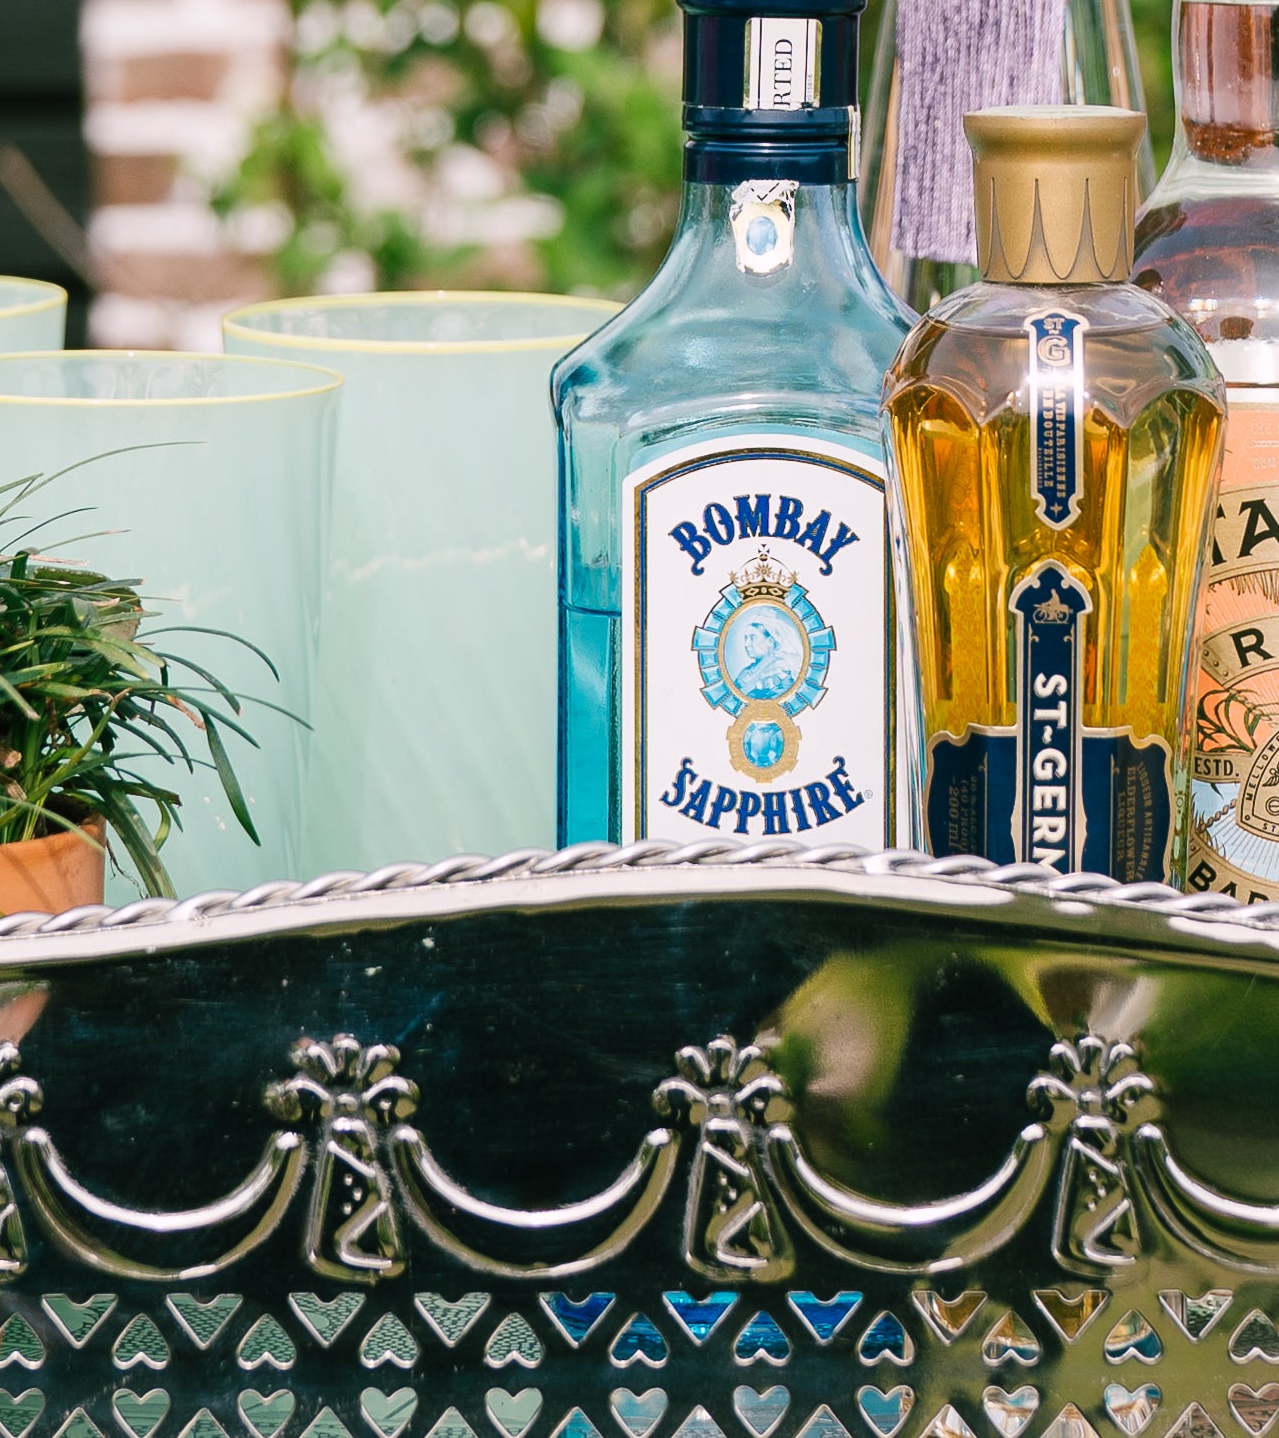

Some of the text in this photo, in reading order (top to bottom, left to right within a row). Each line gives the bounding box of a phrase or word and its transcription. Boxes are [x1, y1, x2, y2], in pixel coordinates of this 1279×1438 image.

[1042, 410, 1054, 488] BOUTEILLE
[668, 493, 860, 576] BOMBAY
[659, 755, 865, 836] SAPPHIRE
[1194, 756, 1240, 778] ESTD.
[1126, 766, 1137, 882] ELDERFLOWER
